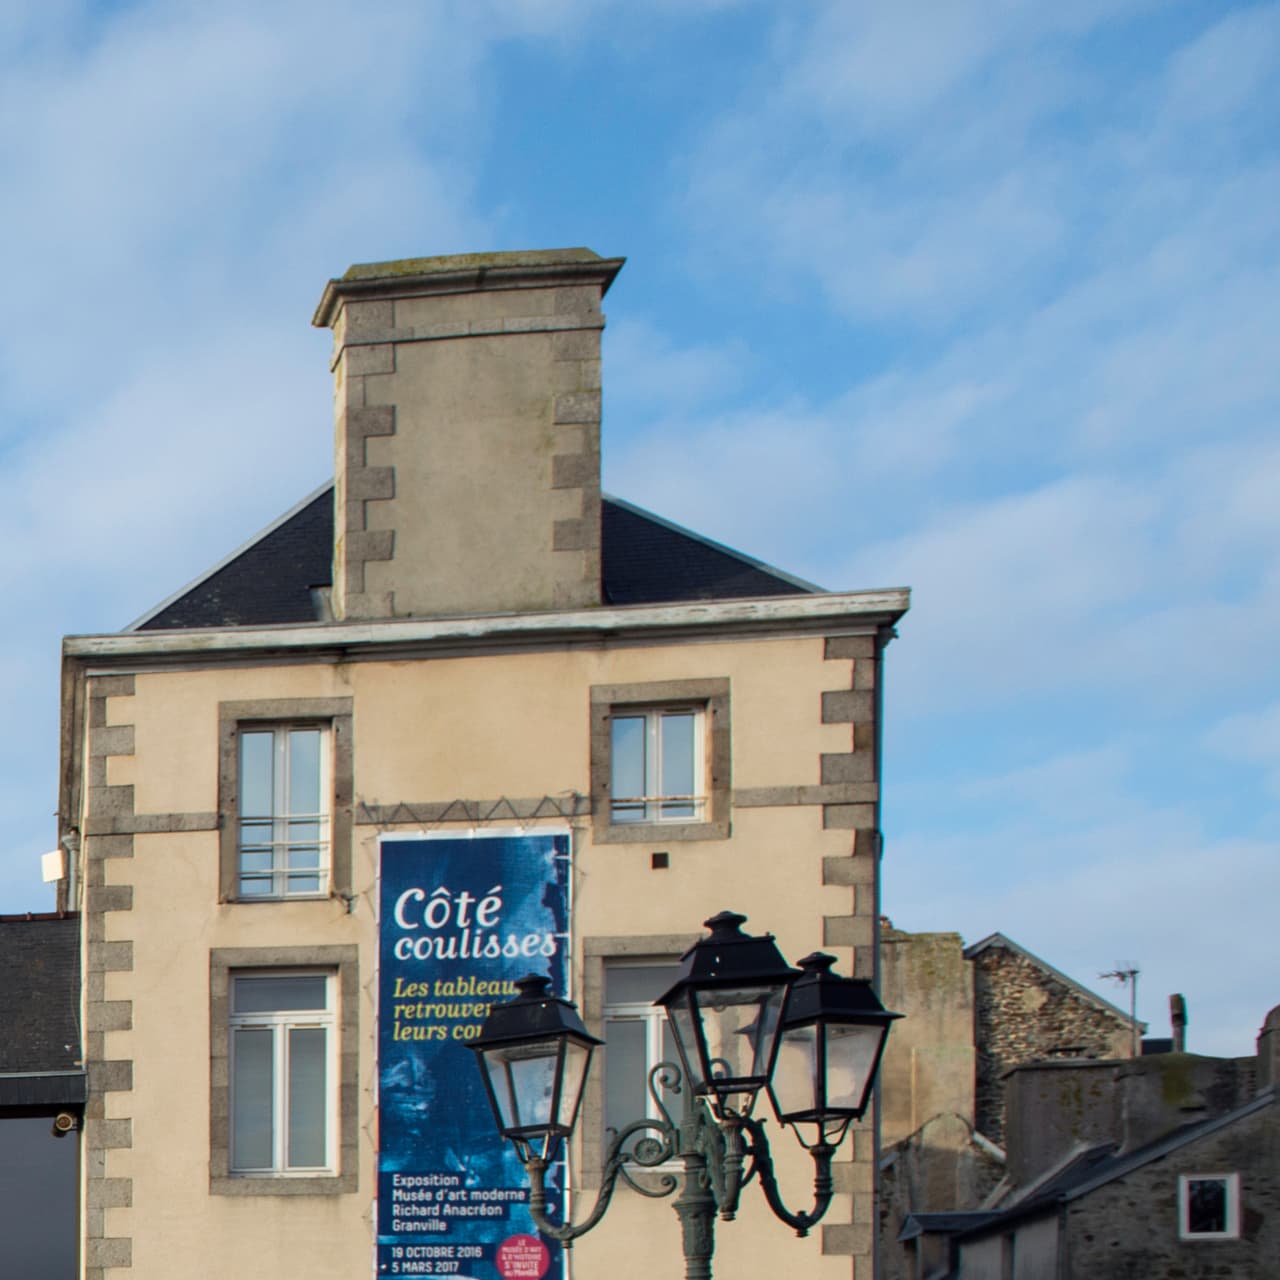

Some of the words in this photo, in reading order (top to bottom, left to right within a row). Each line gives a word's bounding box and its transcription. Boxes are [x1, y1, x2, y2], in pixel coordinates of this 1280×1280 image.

[394, 885, 503, 930] Côté
[394, 929, 557, 960] coulisses
[393, 977, 429, 998] Les
[393, 1021, 448, 1041] leurs
[392, 1174, 459, 1188] Exposition
[392, 1189, 432, 1201] Musée
[436, 1189, 467, 1201] d'art
[470, 1189, 526, 1201] moderne
[392, 1204, 440, 1216] Richard
[443, 1203, 503, 1216] Anacréon
[392, 1220, 447, 1232] Granville
[391, 1247, 404, 1258] 19
[406, 1247, 455, 1258] OCTOBRE
[457, 1246, 483, 1257] 2016
[391, 1262, 400, 1273] 5
[402, 1261, 433, 1273] MARS
[435, 1261, 460, 1272] 2017
